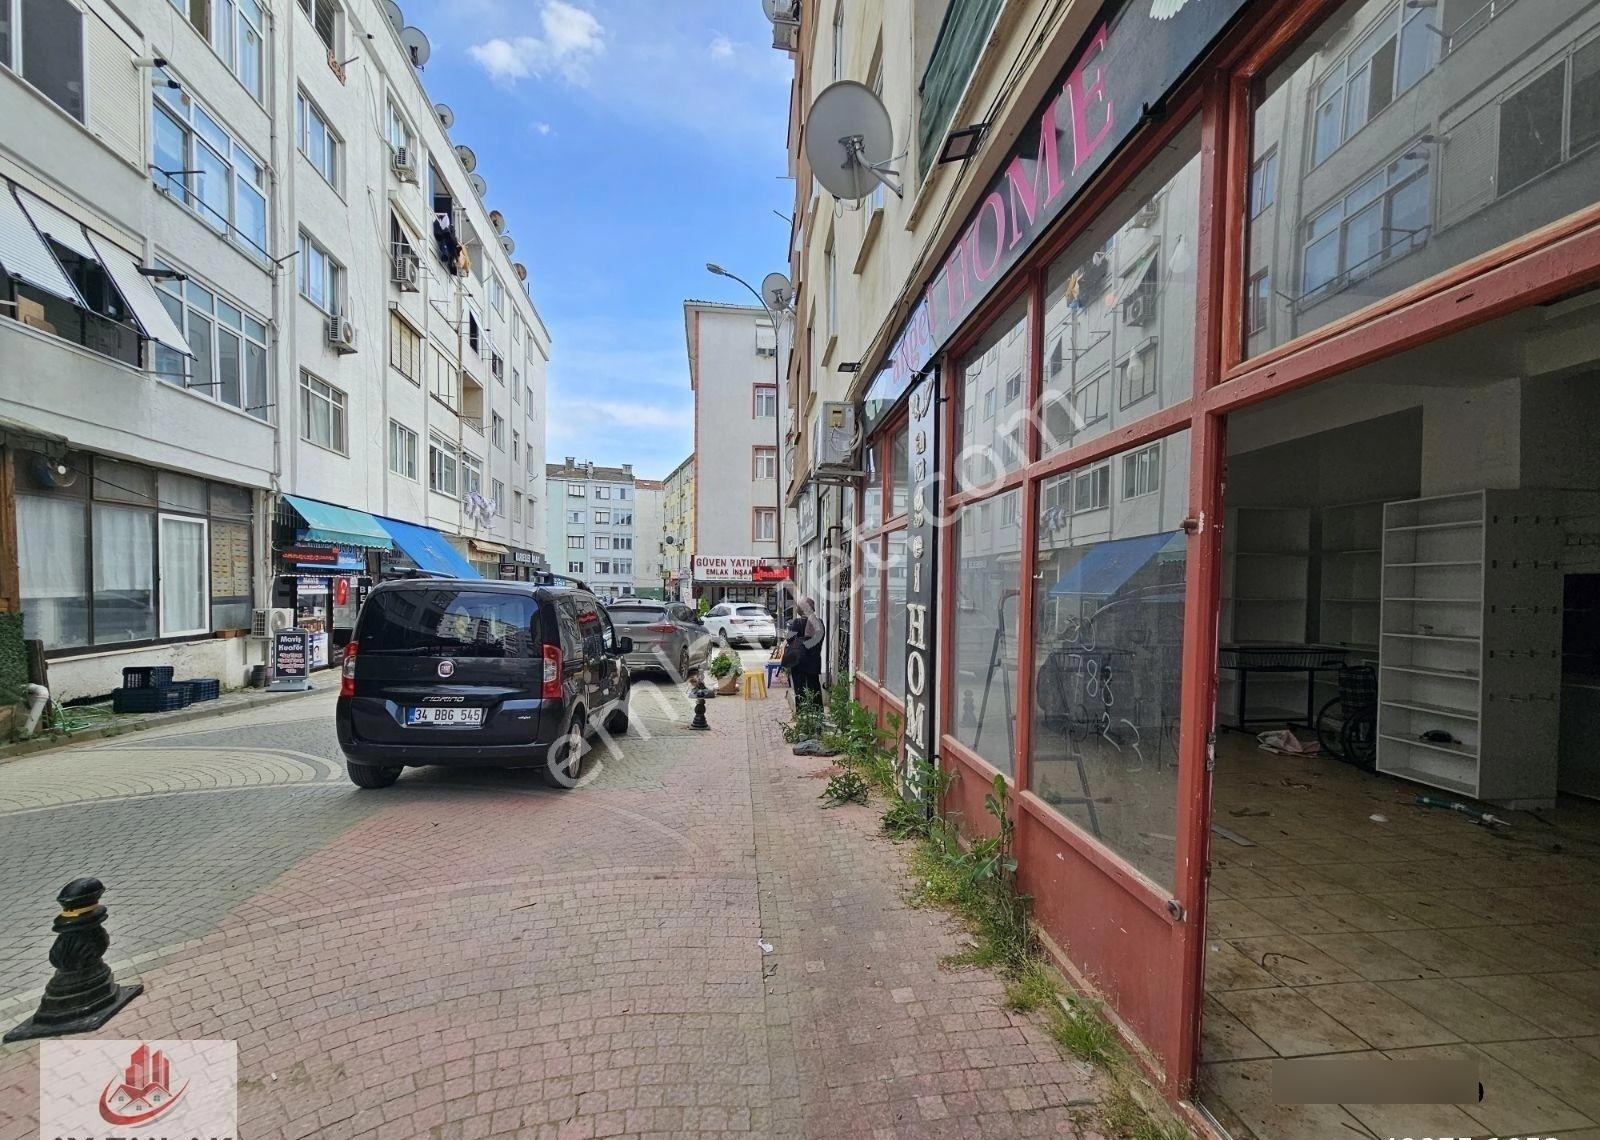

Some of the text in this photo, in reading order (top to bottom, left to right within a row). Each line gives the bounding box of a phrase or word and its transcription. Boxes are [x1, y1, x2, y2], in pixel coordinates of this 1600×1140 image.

[944, 25, 1114, 325] HOME
[696, 557, 767, 568] GÜVEN YATIRIM
[706, 568, 729, 576] EMLAK
[733, 567, 753, 577] İNŞAA
[280, 635, 302, 643] Maviş
[278, 643, 304, 651] Kuaför
[905, 603, 926, 800] HOME
[415, 709, 481, 721] 34 BBG 545
